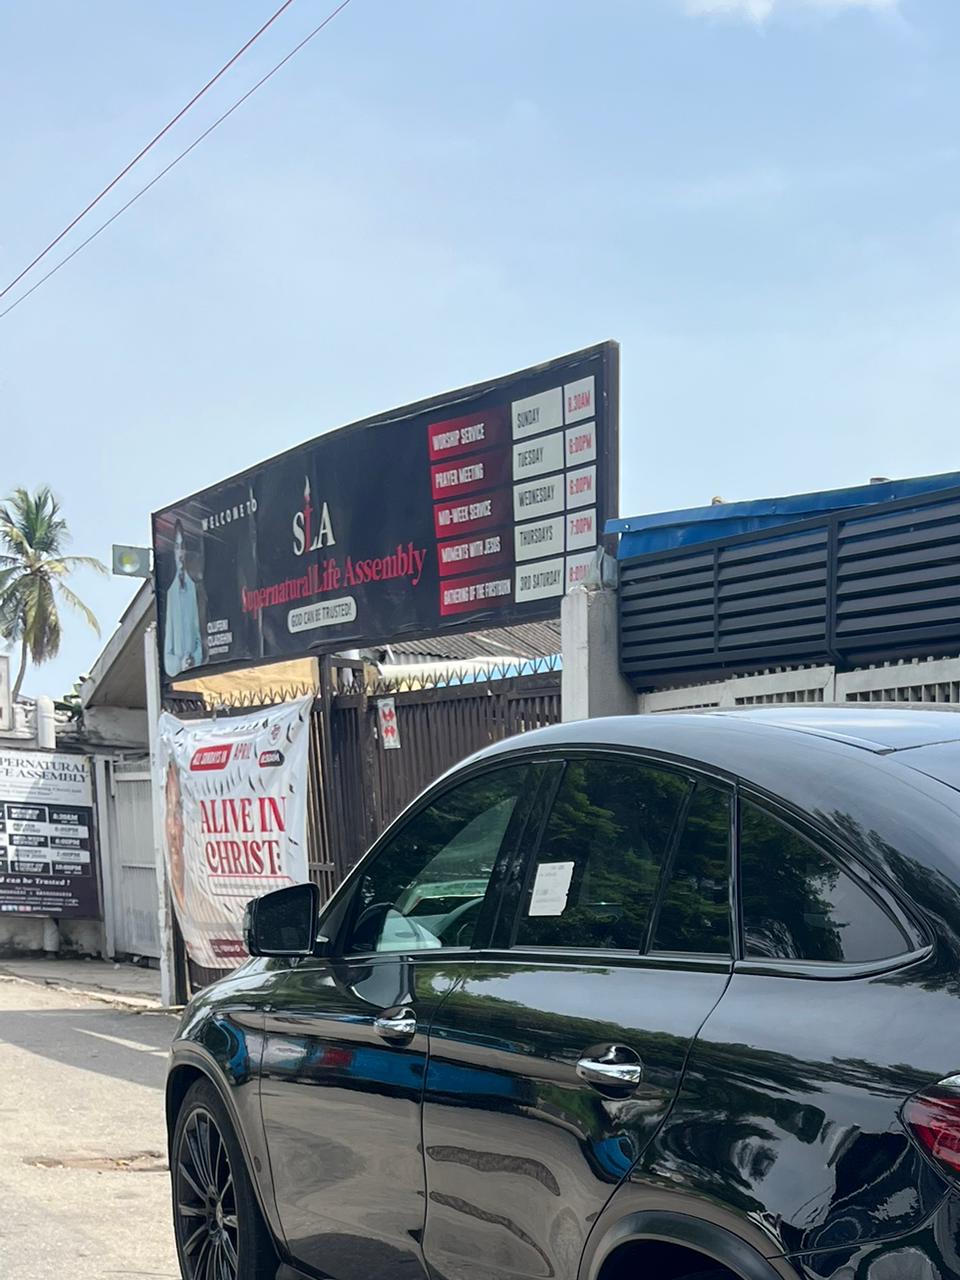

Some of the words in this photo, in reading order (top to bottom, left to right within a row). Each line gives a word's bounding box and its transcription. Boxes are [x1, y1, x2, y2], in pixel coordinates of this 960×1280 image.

[517, 407, 540, 429] SUNDAY
[432, 430, 459, 451] WORSHIP
[460, 423, 485, 444] SERVICE
[517, 447, 544, 468] TUESDAY
[435, 469, 459, 488] PRAYER
[459, 463, 484, 483] MEETING
[518, 485, 555, 507] WEDNESDAY
[202, 504, 244, 531] WELCOME
[246, 498, 258, 515] TO
[438, 506, 469, 526] MID-WEEK
[469, 500, 491, 520] SERVICE
[293, 502, 336, 556] SLA
[520, 525, 553, 547] THURSDAYS
[484, 536, 501, 554] JESUS
[242, 566, 313, 620] Supernatural
[313, 558, 340, 594] Life
[344, 542, 426, 587] Assembly
[520, 575, 531, 591] 3RD
[533, 569, 561, 589] SATURDAY
[291, 612, 303, 628] GOD
[303, 610, 314, 625] CAN
[315, 607, 321, 622] BE
[17, 769, 89, 783] ASSEMBLY
[200, 797, 254, 833] ALIVE
[258, 796, 287, 833] IN
